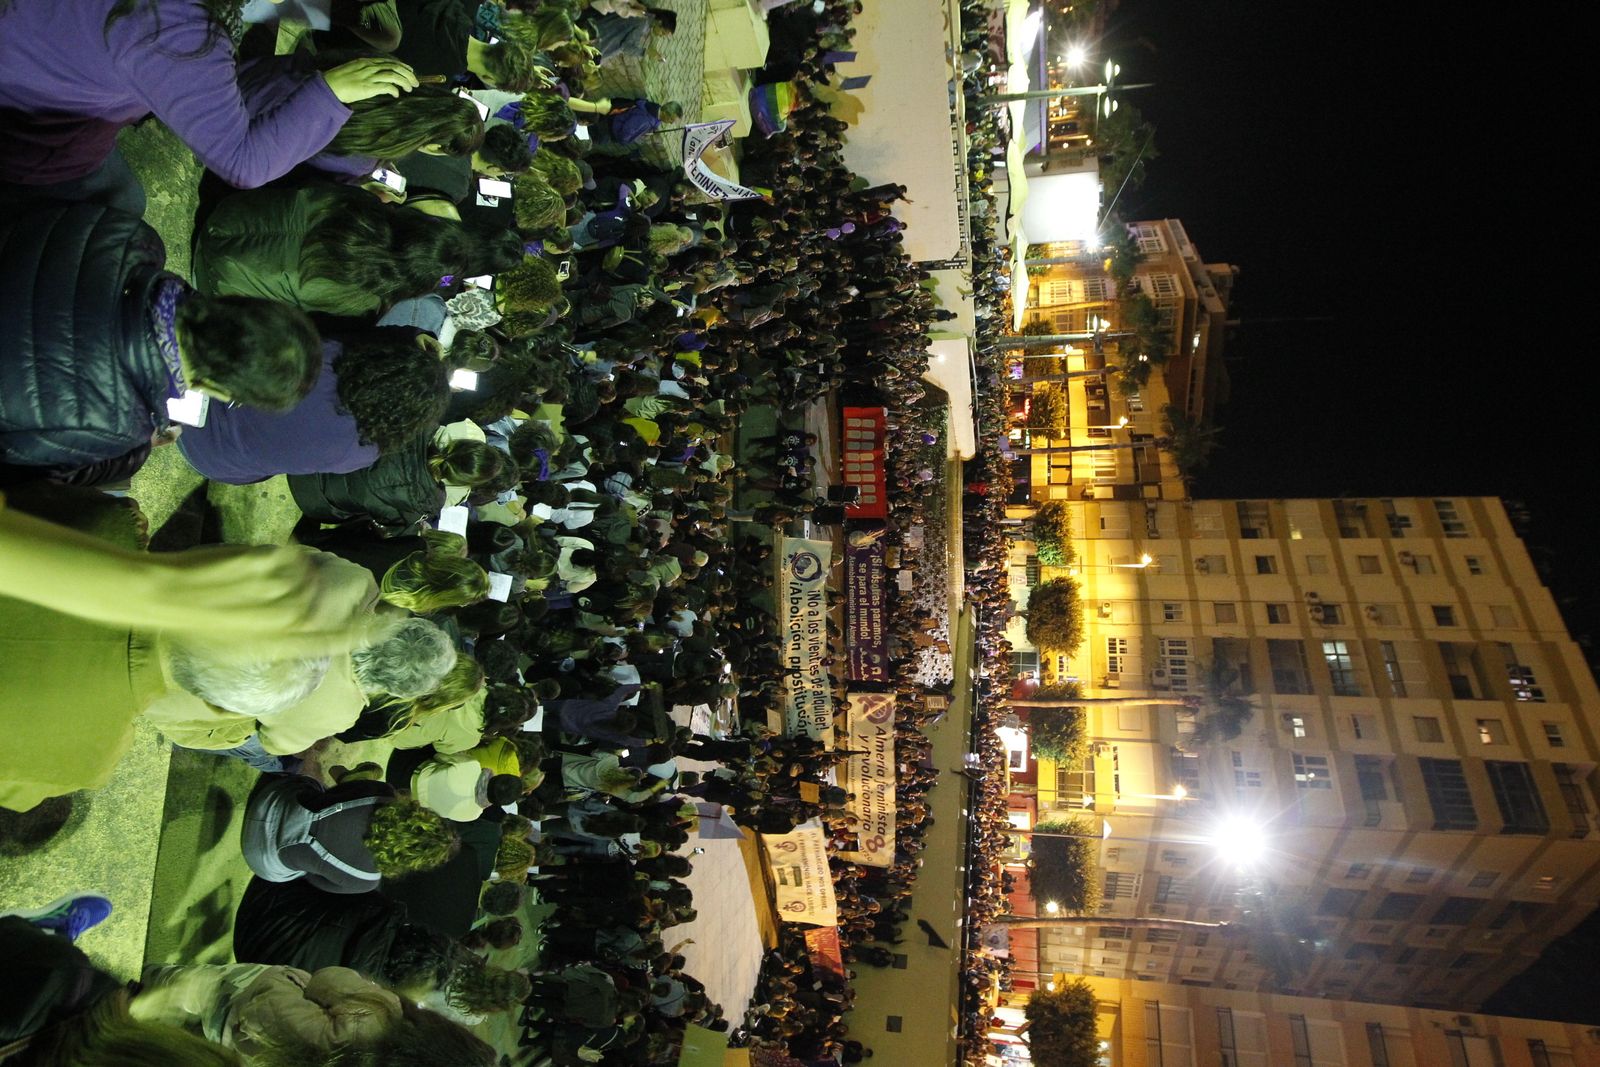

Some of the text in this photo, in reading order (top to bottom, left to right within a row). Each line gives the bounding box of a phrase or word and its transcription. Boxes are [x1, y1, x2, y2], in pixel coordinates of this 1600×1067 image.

[688, 159, 728, 199] FEMINIST
[857, 563, 870, 640] se para el mundo!
[808, 620, 822, 634] los
[870, 608, 882, 648] paramos,
[808, 637, 823, 676] vientres
[811, 678, 824, 688] de
[811, 690, 829, 730] alquiler!
[858, 734, 873, 832] y revolucionaria
[874, 726, 888, 836] Almería feminista
[866, 835, 886, 853] 8
